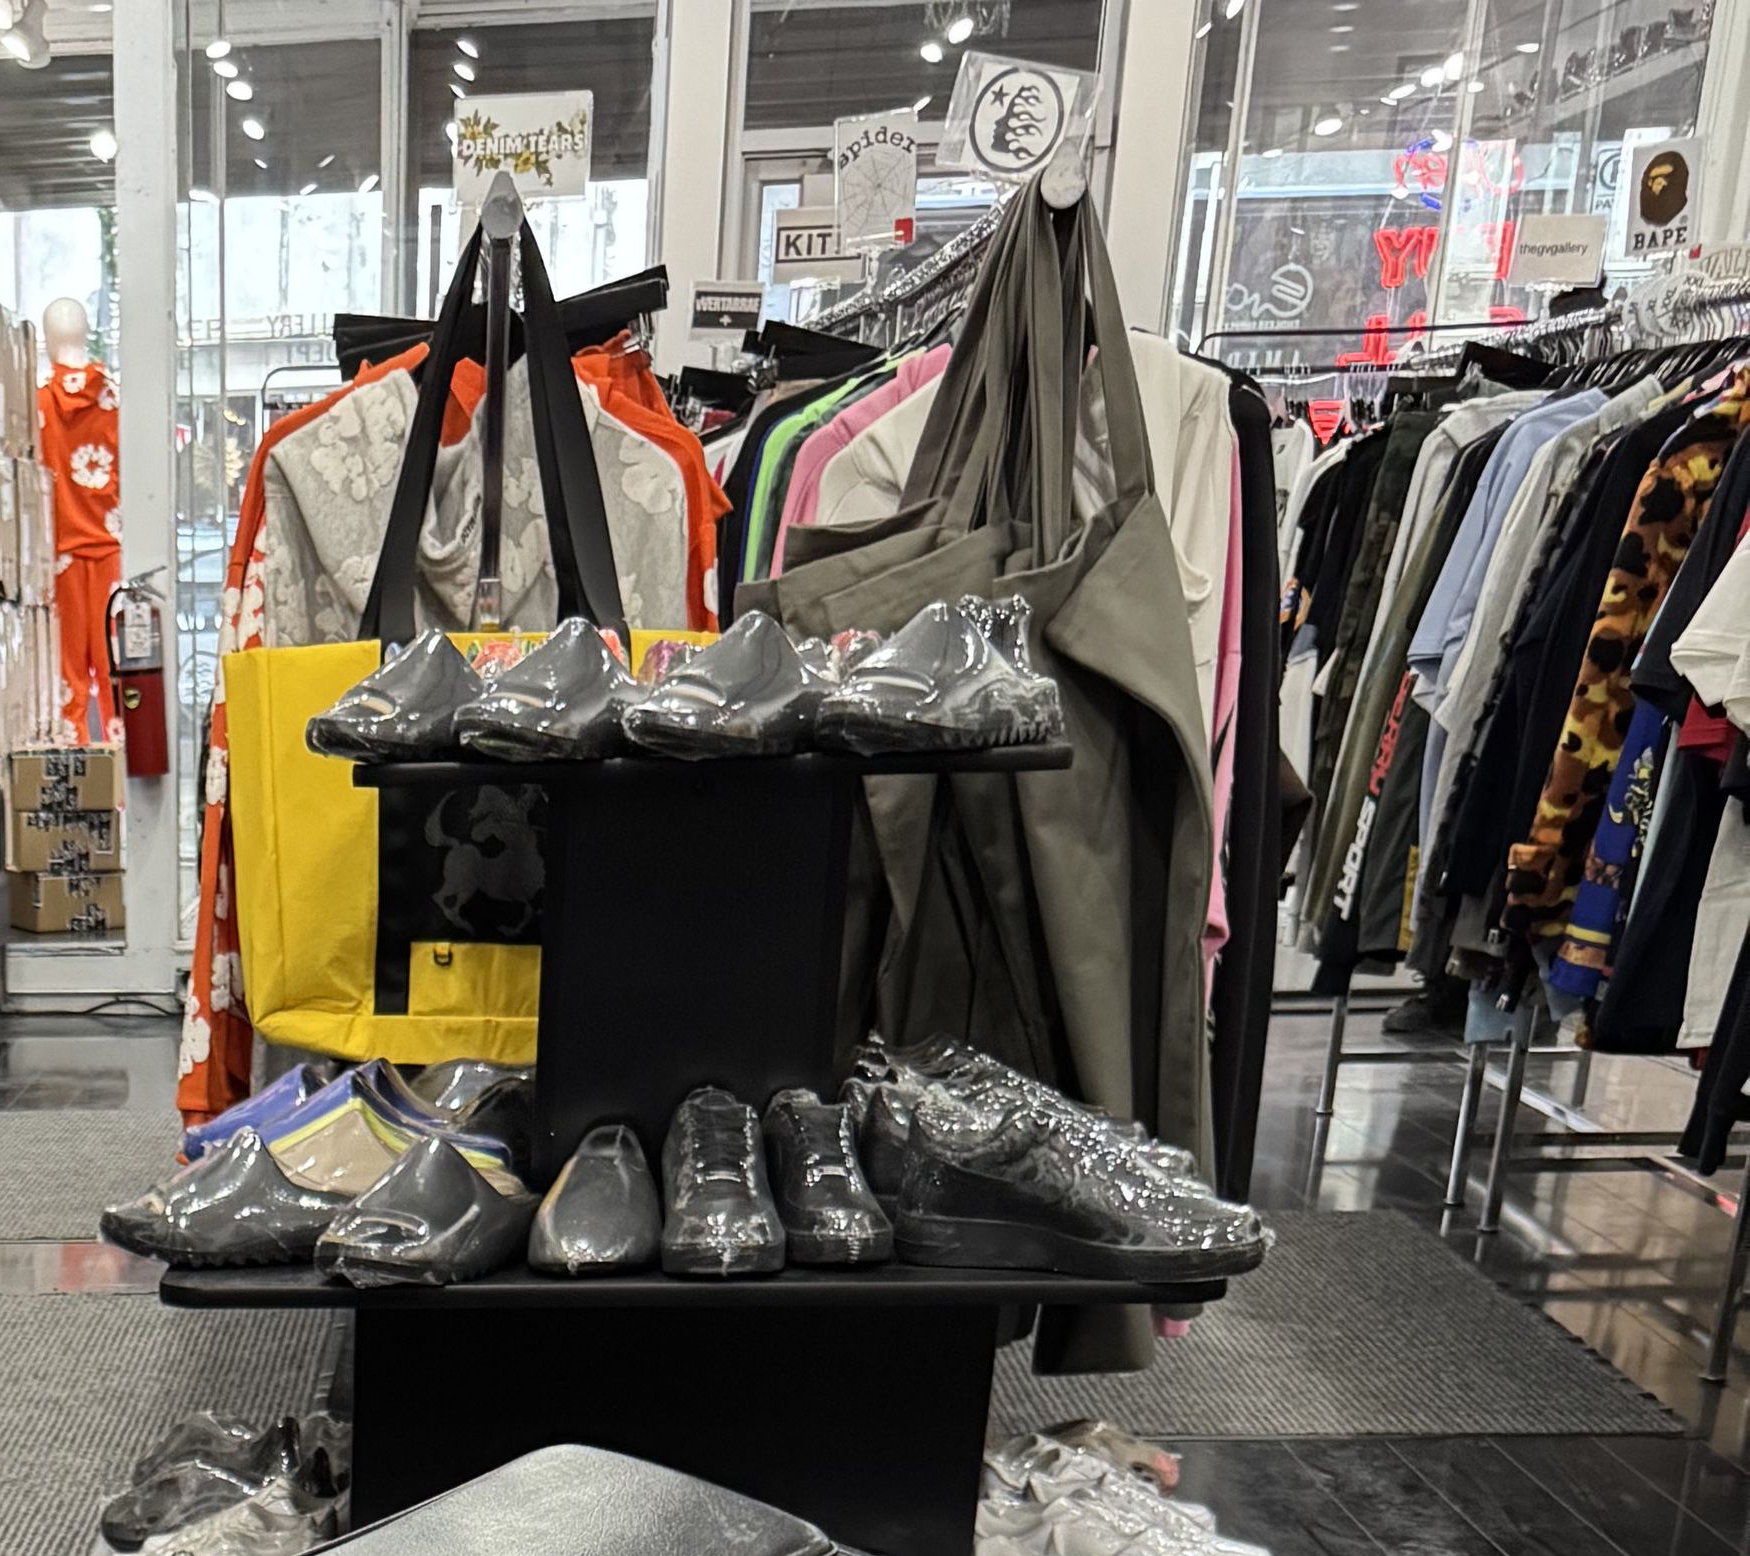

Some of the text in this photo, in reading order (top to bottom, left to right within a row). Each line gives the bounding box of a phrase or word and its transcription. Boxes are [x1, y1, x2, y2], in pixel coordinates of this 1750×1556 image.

[462, 133, 586, 156] DENIM TEARS
[1519, 240, 1590, 256] thegvgallery
[1632, 226, 1688, 251] BAPE
[1333, 795, 1376, 921] SPORT
